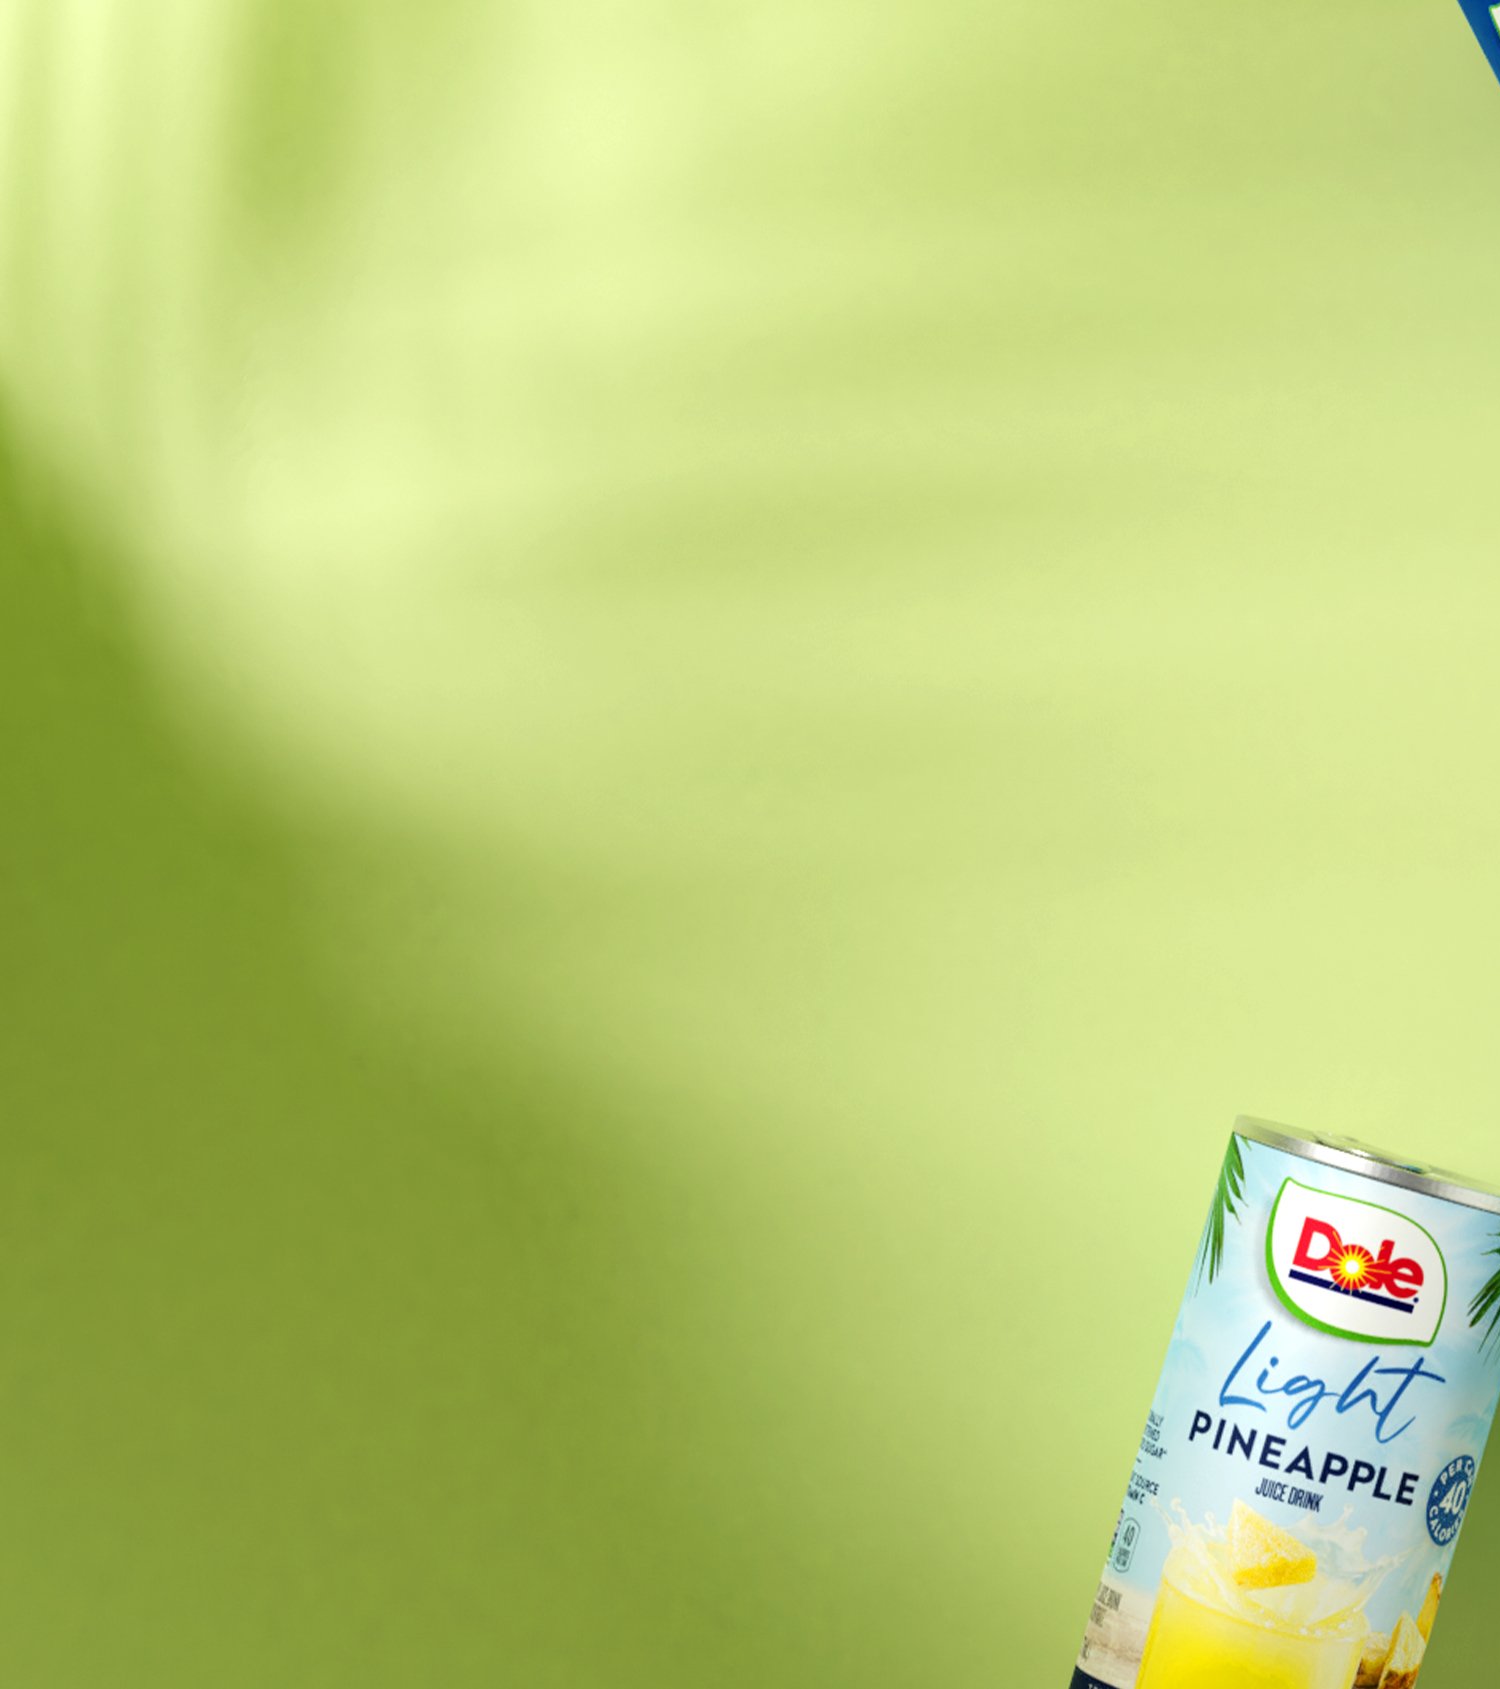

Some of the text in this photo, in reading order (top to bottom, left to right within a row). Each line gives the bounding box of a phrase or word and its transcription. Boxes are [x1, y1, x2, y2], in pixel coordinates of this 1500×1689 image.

[1292, 1216, 1424, 1299] Dole
[1219, 1320, 1446, 1444] Light
[1188, 1410, 1420, 1506] PINEAPPLE
[1441, 1459, 1462, 1485] PER
[1255, 1478, 1323, 1513] JUICE DRINK
[1439, 1480, 1467, 1515] 40
